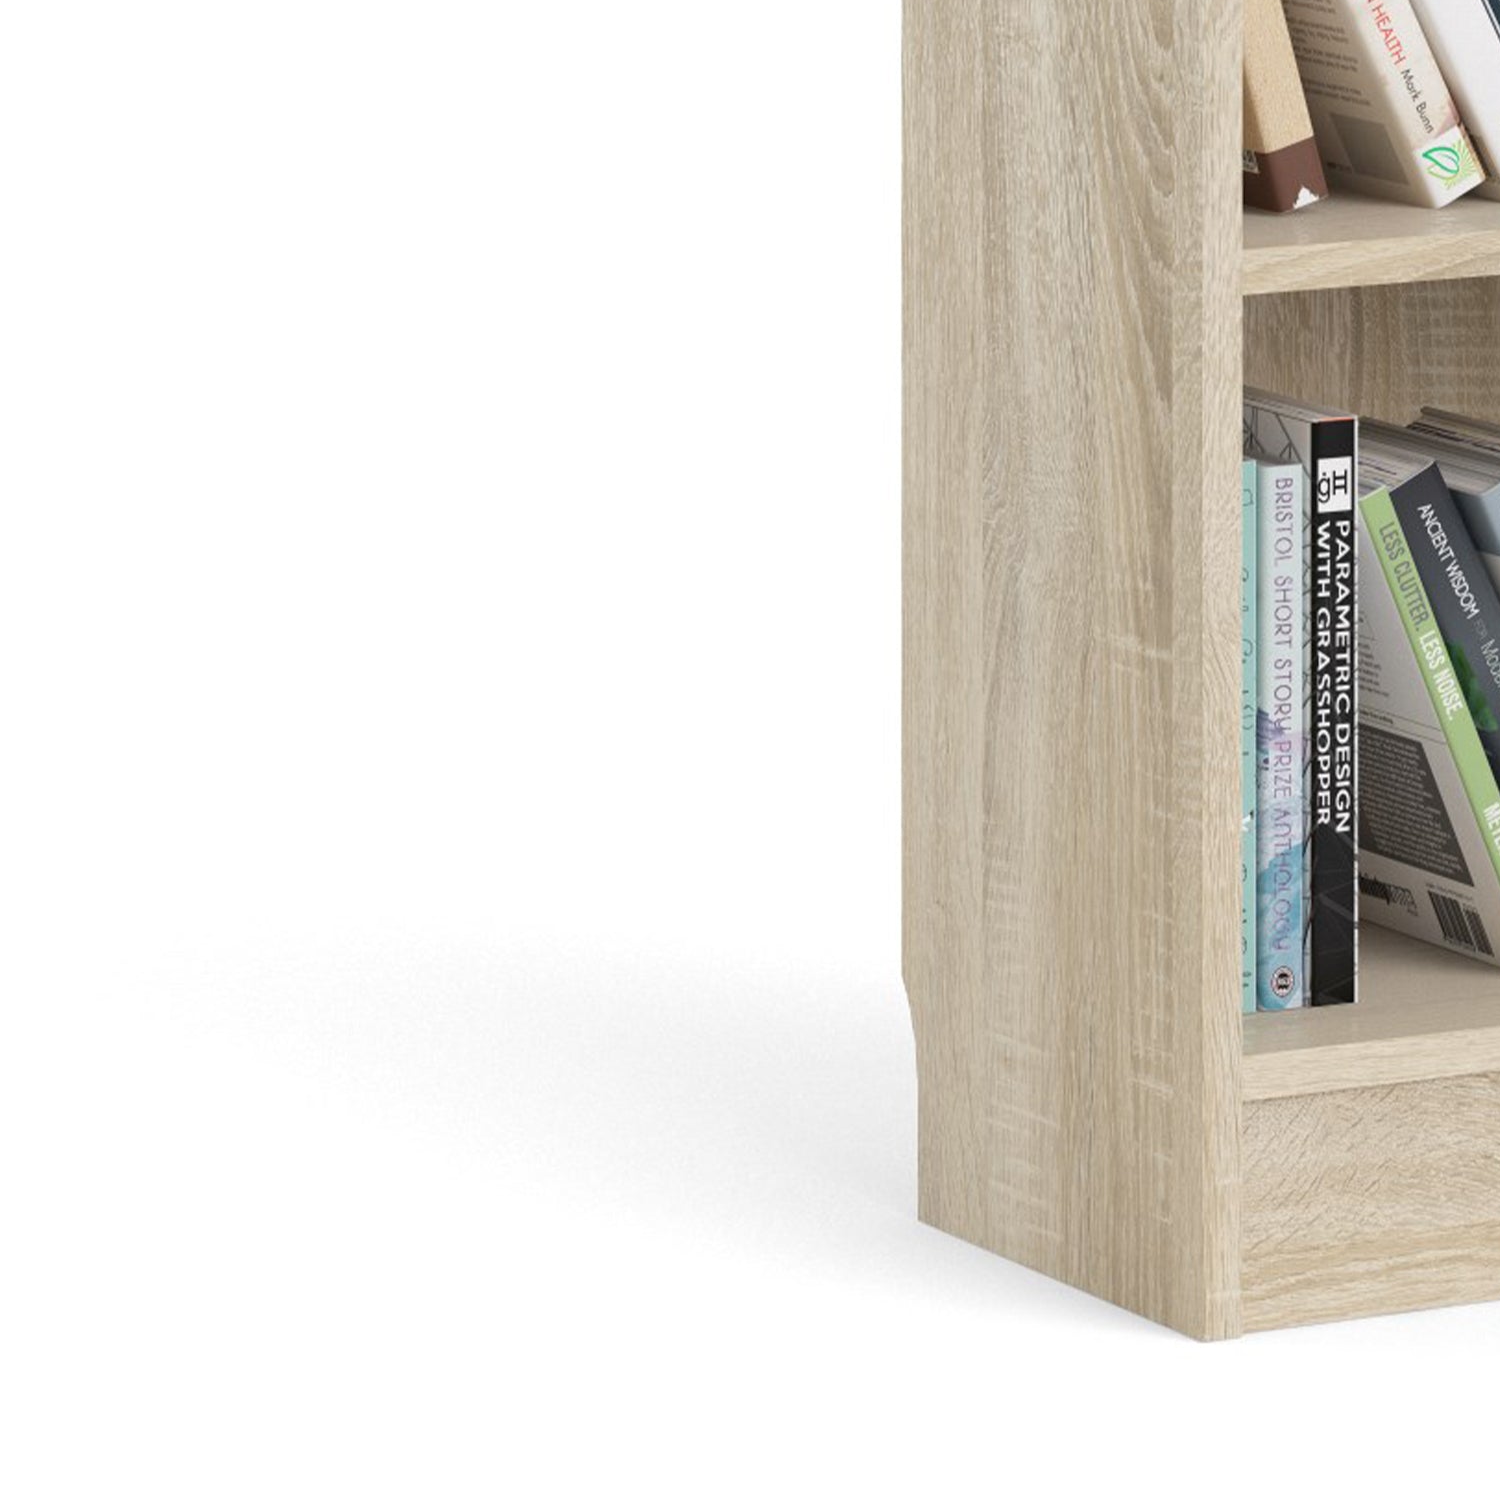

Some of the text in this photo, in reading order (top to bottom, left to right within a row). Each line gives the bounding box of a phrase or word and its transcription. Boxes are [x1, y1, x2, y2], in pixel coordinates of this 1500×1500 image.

[1371, 3, 1406, 65] HEALTH
[1401, 68, 1422, 102] Mark
[1416, 101, 1434, 134] Bunn
[1274, 477, 1294, 567] BRISTOL
[1417, 503, 1454, 561] ANCIENT
[1445, 560, 1480, 619] WISDOM
[1274, 575, 1293, 648] SHORT
[1317, 521, 1331, 825] WITH GRASSHOPPER
[1379, 521, 1464, 720] LESS CLUTTER. LESS NOISE.
[1274, 658, 1293, 731] STORY
[1335, 520, 1350, 833] PARAMETRIC DESIGN
[1274, 741, 1293, 799] PRIZE
[1272, 807, 1293, 950] ANTHOLOGY
